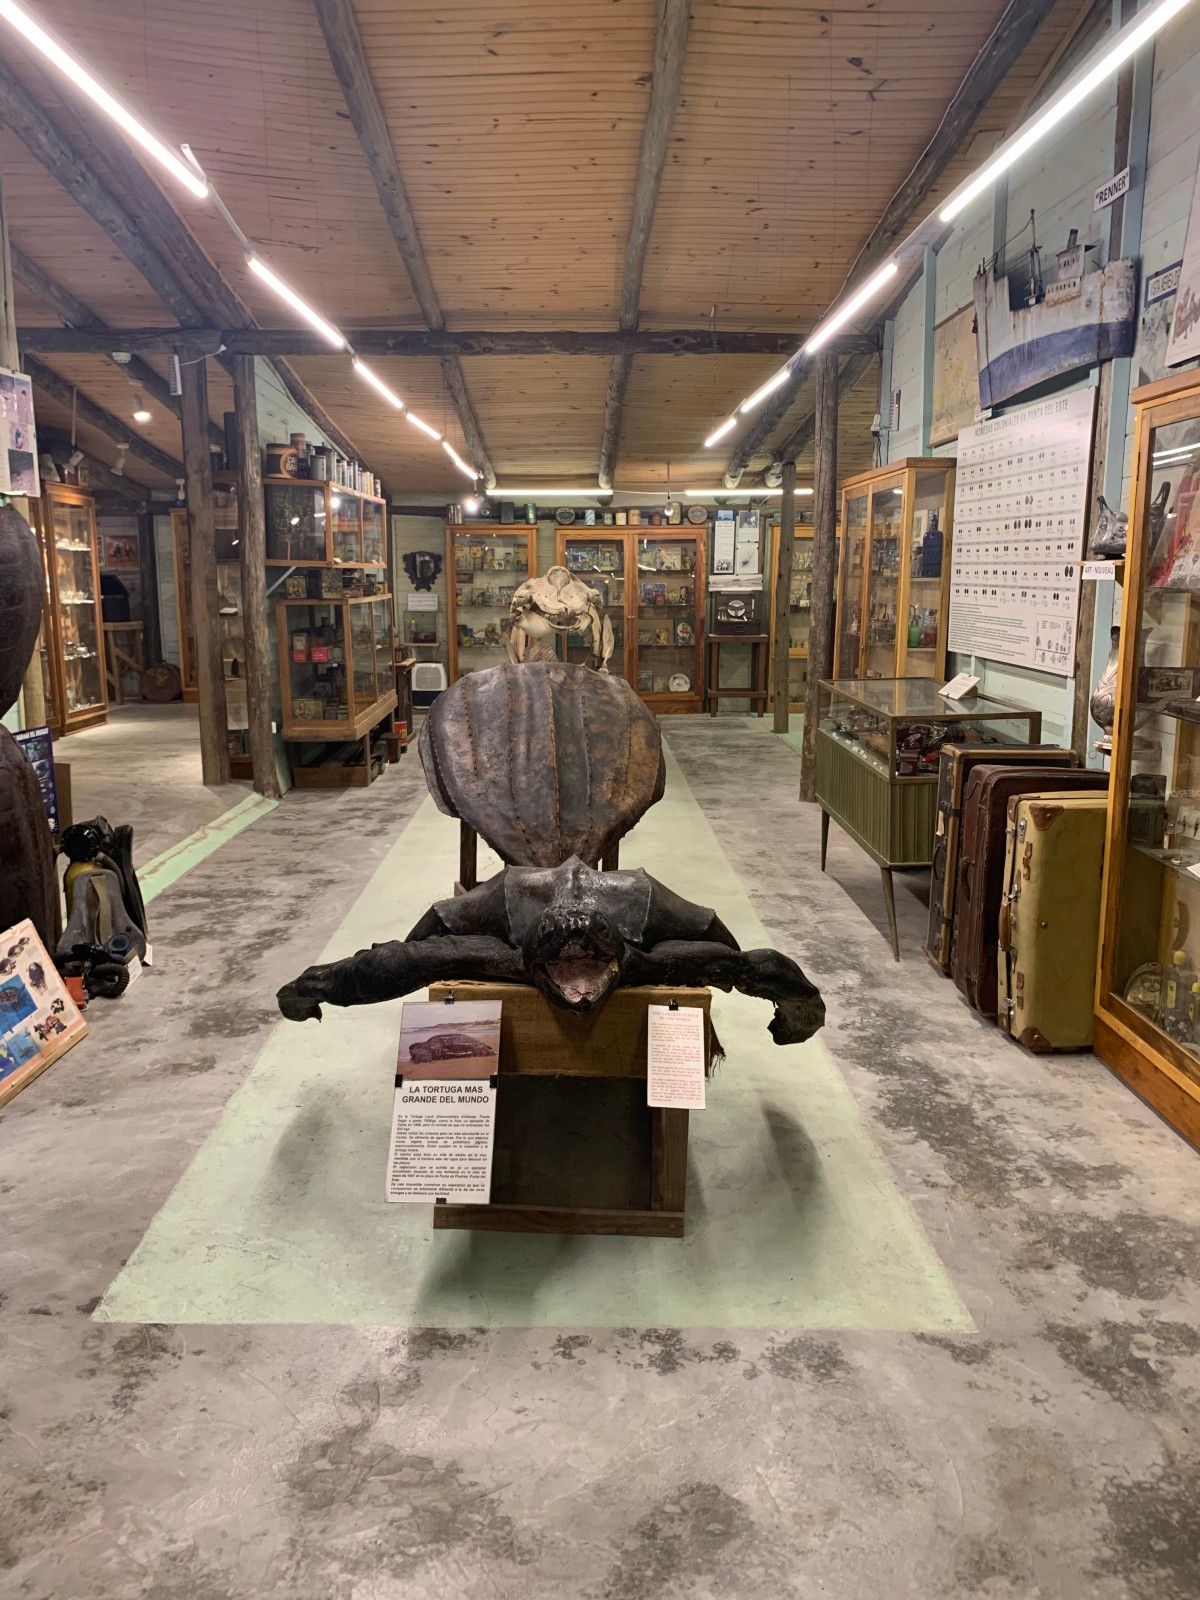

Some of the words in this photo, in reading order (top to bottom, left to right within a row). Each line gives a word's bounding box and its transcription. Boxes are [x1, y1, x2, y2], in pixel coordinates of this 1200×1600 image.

[1056, 398, 1069, 413] ESTE
[410, 1086, 420, 1094] LA
[422, 1086, 462, 1094] TORTUGA
[464, 1086, 483, 1094] MAS
[402, 1096, 438, 1104] GRANDE
[440, 1096, 456, 1104] DEL
[458, 1096, 489, 1104] MUNDO
